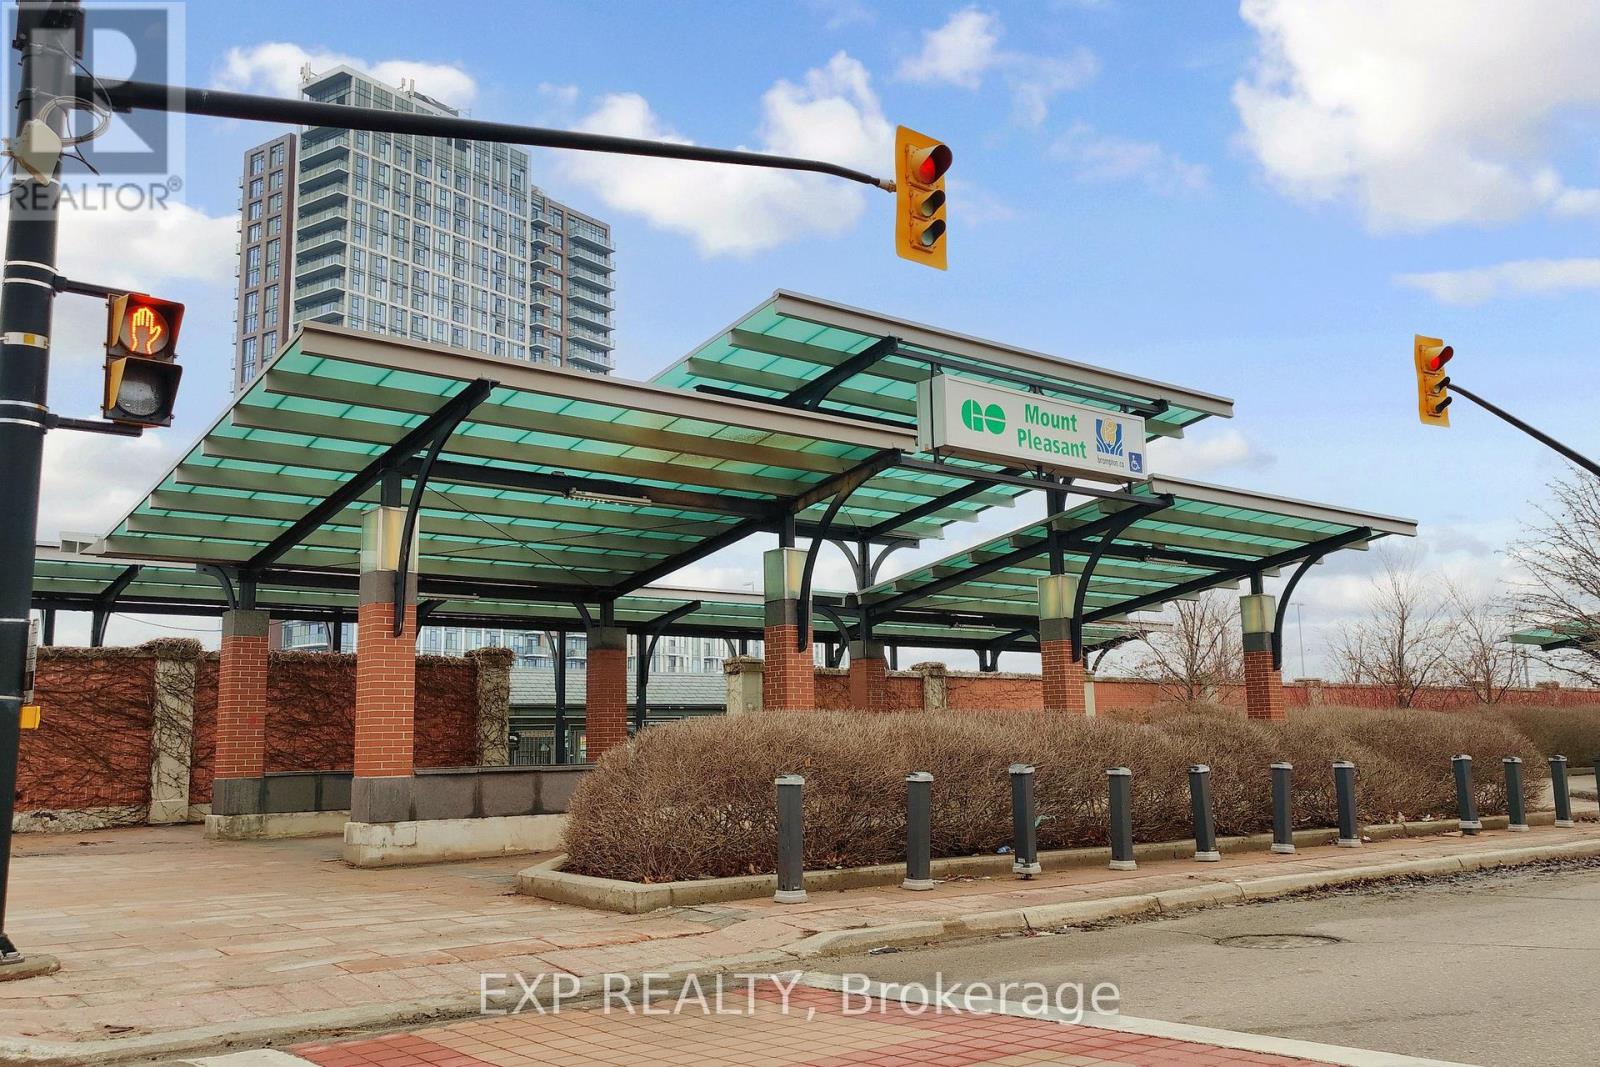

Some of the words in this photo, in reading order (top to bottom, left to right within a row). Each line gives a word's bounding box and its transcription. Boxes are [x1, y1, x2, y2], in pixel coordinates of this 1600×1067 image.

[961, 399, 1006, 435] GO
[1025, 404, 1077, 432] Mount
[1018, 428, 1087, 459] Pleasant
